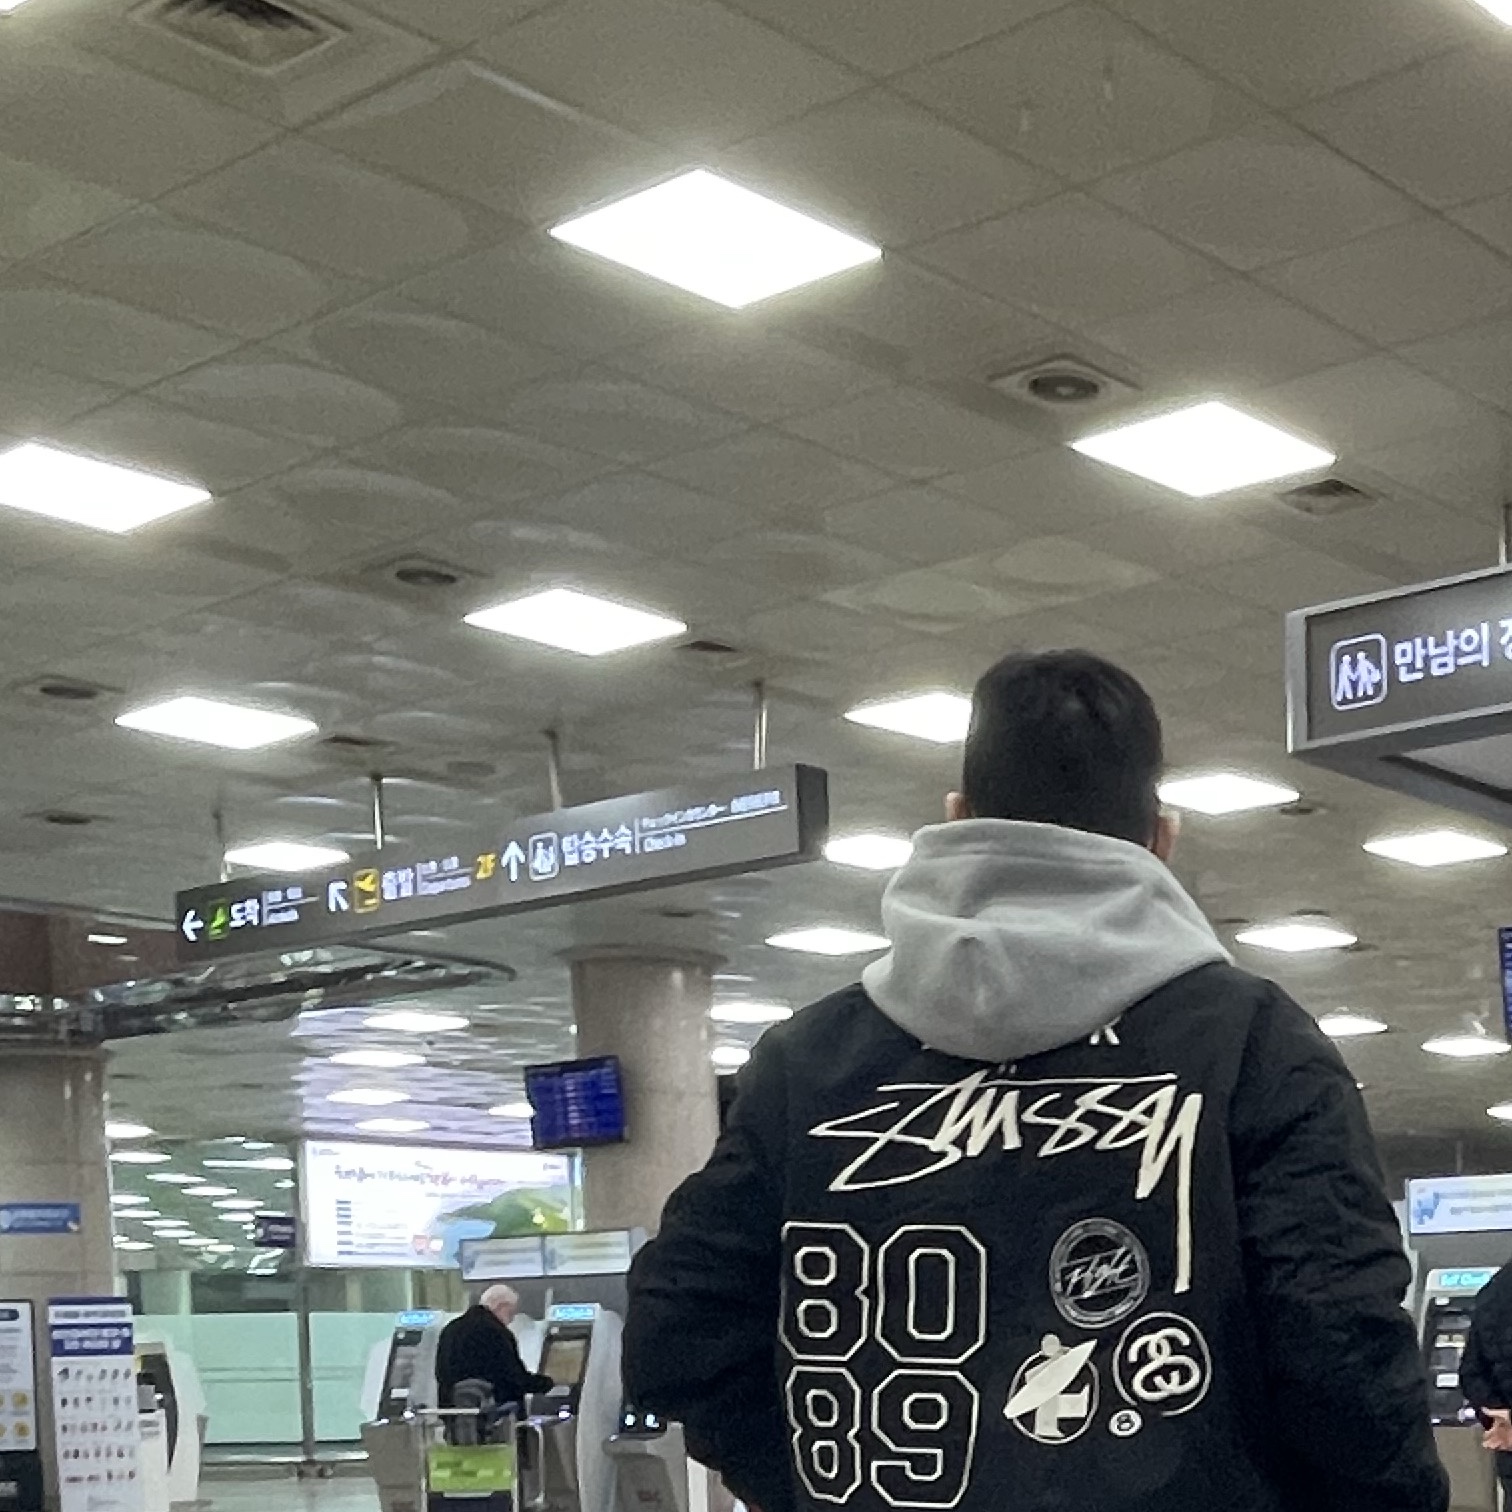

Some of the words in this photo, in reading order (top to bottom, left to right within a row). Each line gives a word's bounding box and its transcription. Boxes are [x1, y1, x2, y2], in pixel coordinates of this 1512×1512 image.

[1394, 621, 1490, 683] 만남의
[779, 1221, 988, 1365] 80
[784, 1365, 981, 1511] 89
